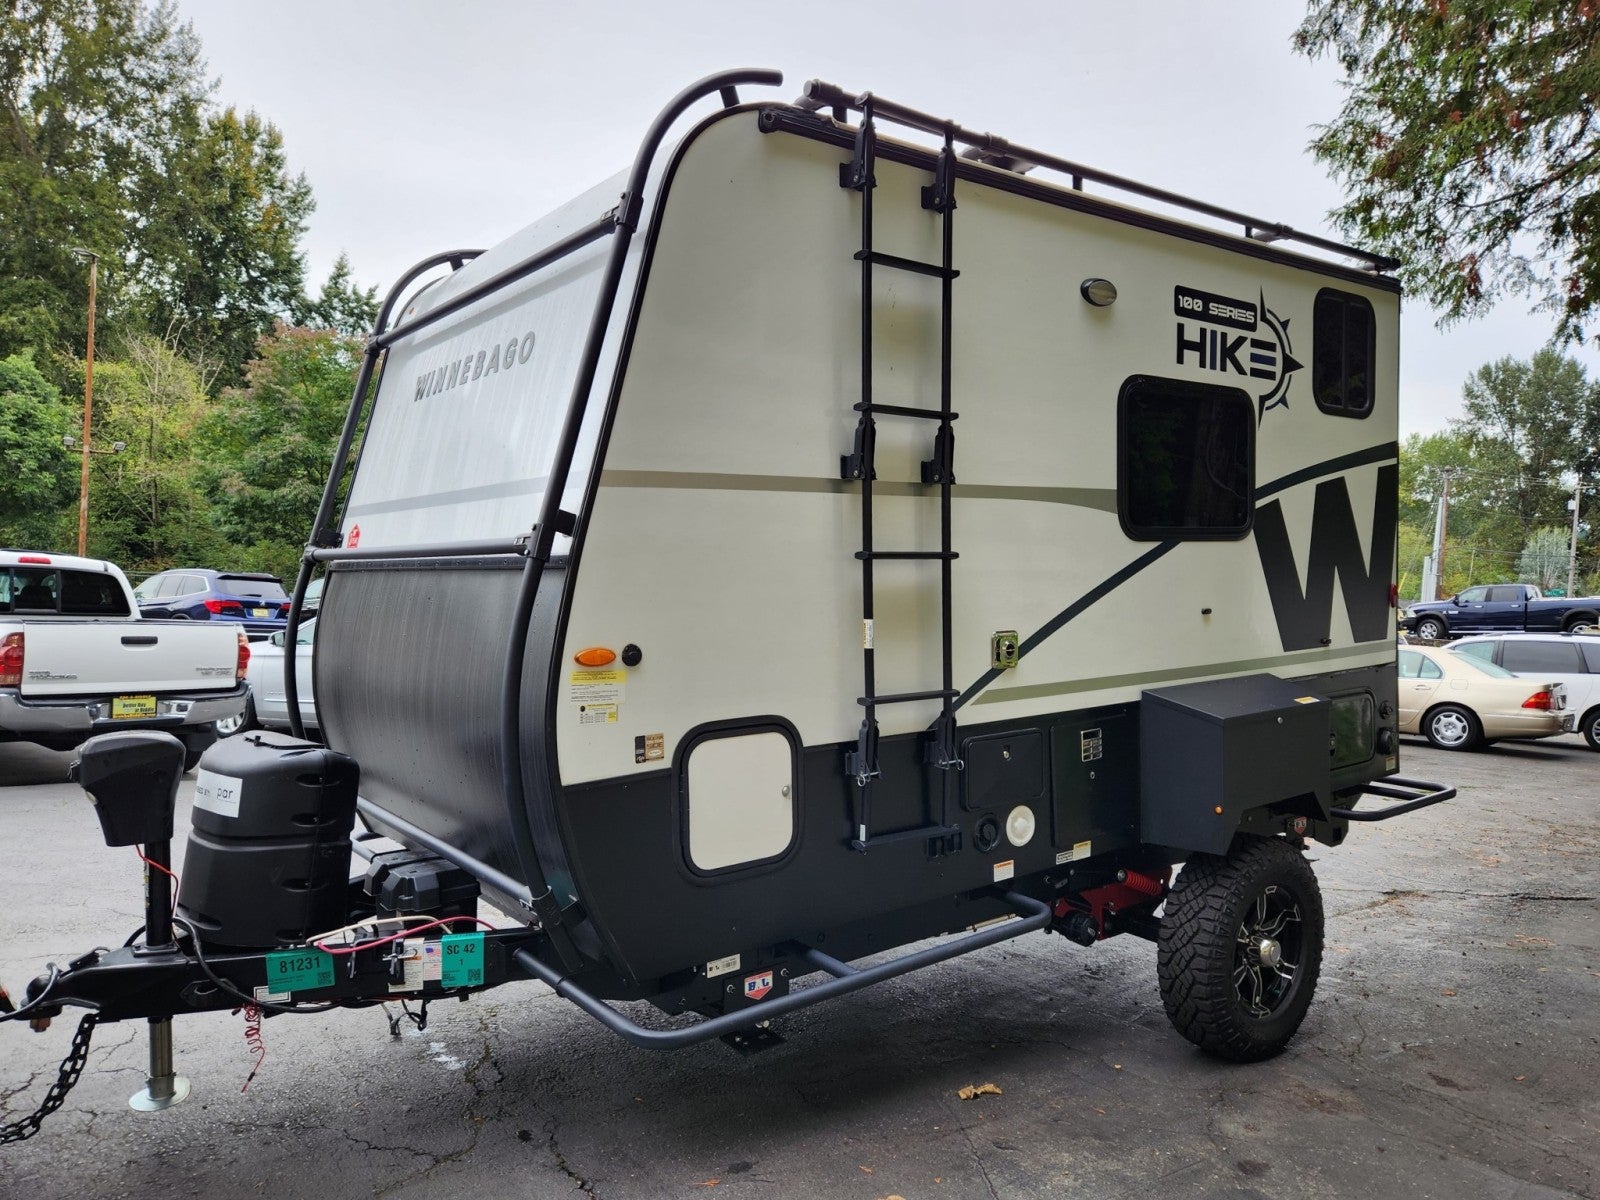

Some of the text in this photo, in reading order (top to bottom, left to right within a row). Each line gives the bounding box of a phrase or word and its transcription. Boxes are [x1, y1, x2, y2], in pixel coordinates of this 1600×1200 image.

[1178, 294, 1255, 323] 100 SERIES
[413, 330, 536, 402] WINNEBAGO
[1176, 322, 1277, 381] HIKE
[446, 943, 475, 955] SC 42
[280, 956, 321, 974] 81231
